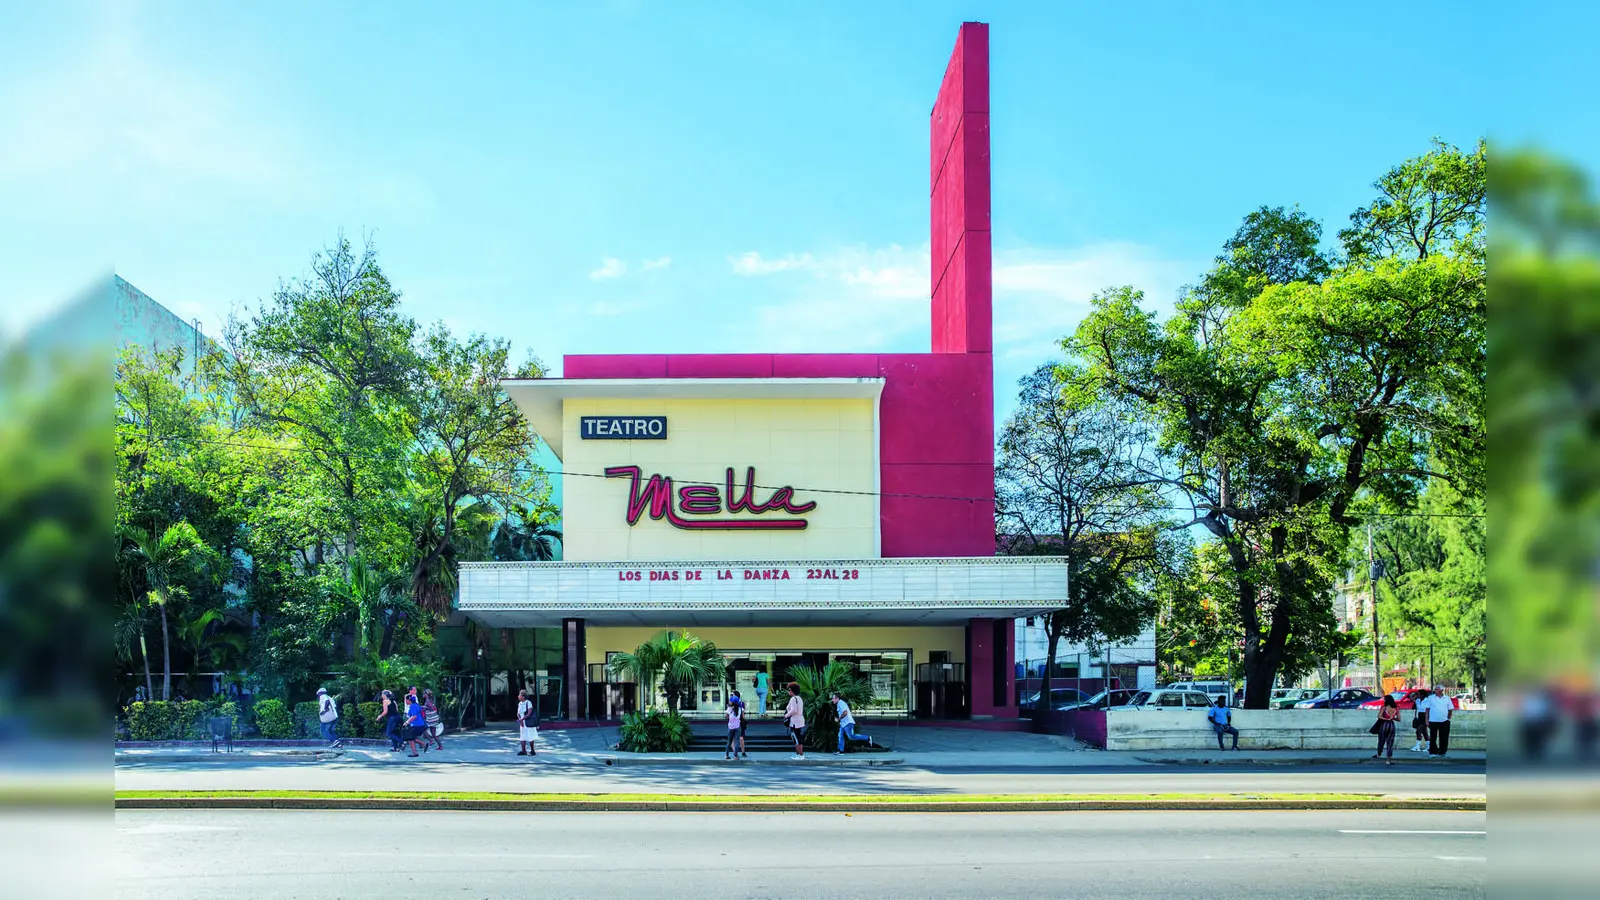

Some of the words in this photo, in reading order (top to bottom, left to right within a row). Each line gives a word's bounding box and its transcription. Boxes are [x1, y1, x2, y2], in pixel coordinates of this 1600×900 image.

[584, 419, 663, 435] TEATRO
[604, 465, 817, 530] Mella
[619, 570, 642, 581] LOS
[649, 570, 679, 581] DIAS
[685, 570, 702, 581] DE
[717, 569, 733, 580] LA
[743, 569, 790, 580] DANZA
